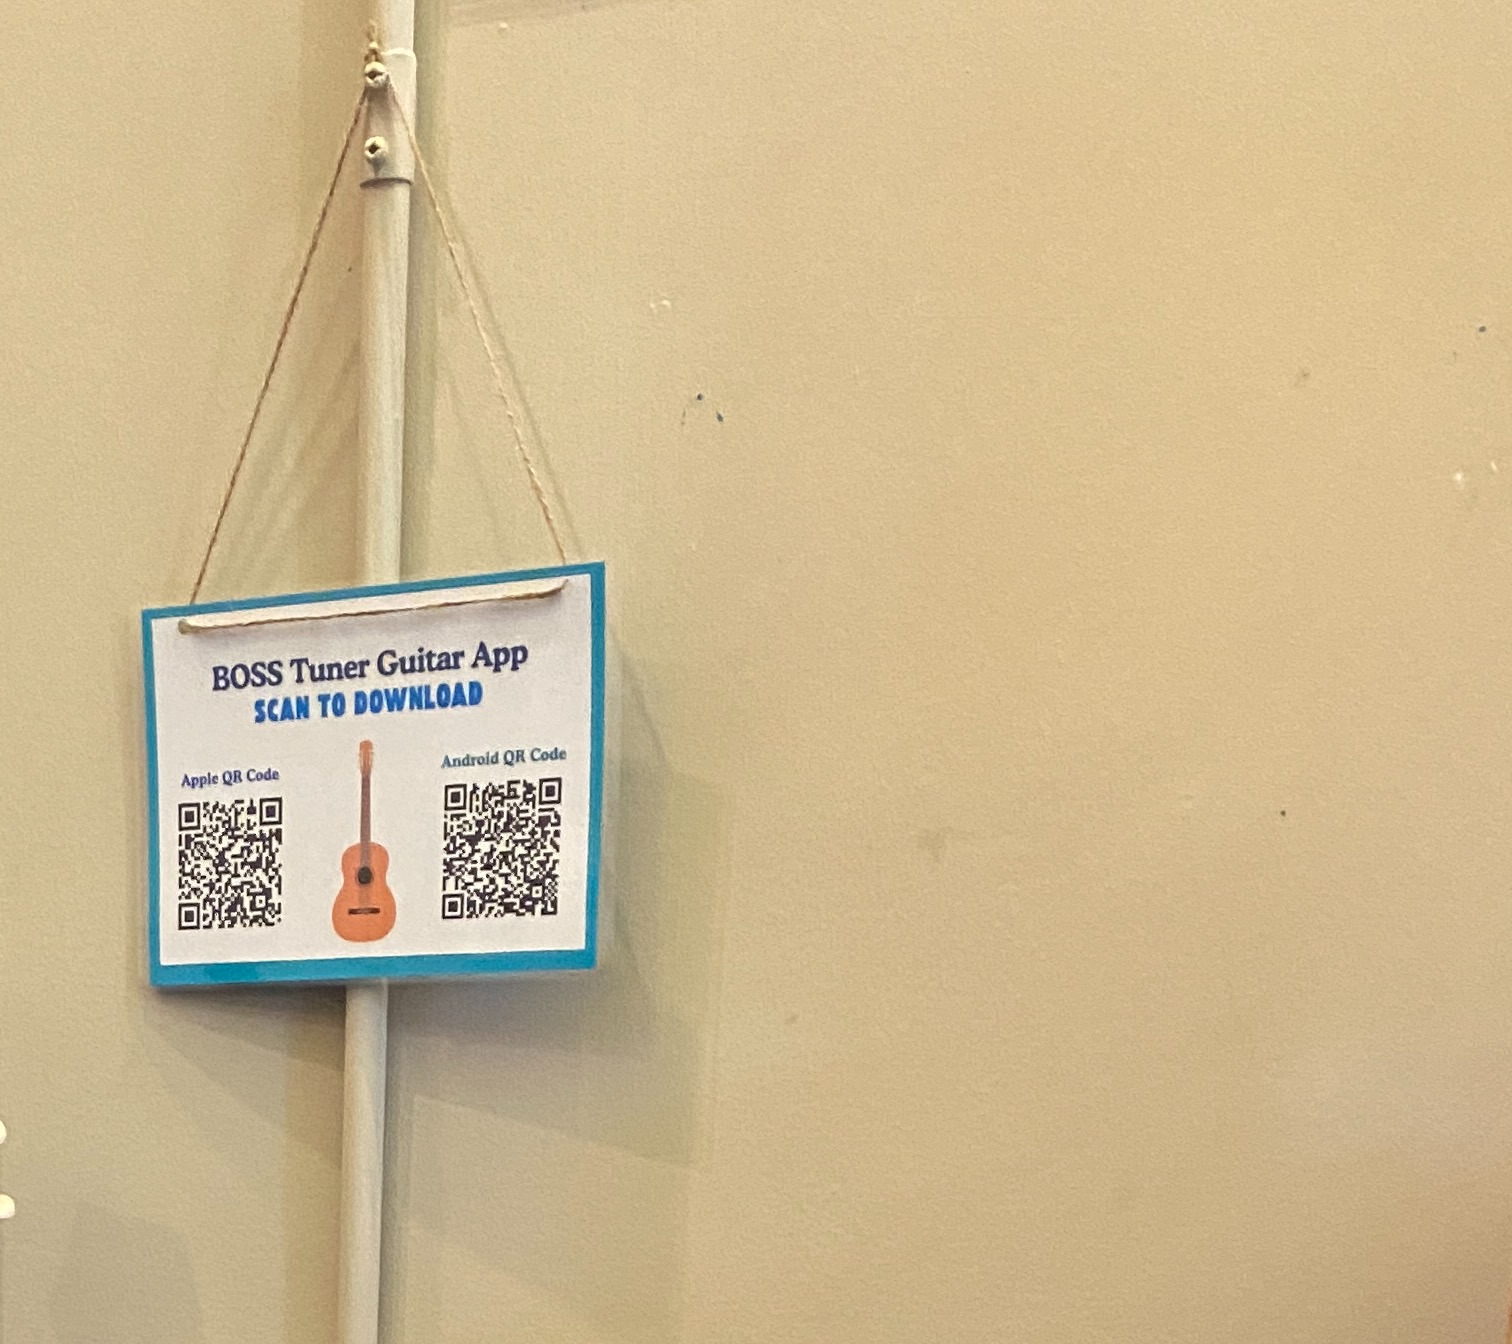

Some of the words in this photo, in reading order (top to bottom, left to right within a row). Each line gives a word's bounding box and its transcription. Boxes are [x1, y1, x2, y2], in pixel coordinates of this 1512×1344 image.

[212, 661, 284, 691] BOSS
[290, 656, 370, 684] Tuner
[377, 647, 465, 676] Guitar
[471, 641, 529, 673] App
[254, 694, 310, 723] SCAN
[317, 691, 346, 718] TO
[354, 680, 484, 716] DOWNLOAD
[441, 751, 499, 769] Android
[503, 749, 526, 766] QR
[530, 747, 567, 761] Code
[181, 772, 219, 789] Apple
[222, 769, 243, 786] QR
[246, 767, 280, 782] Code
